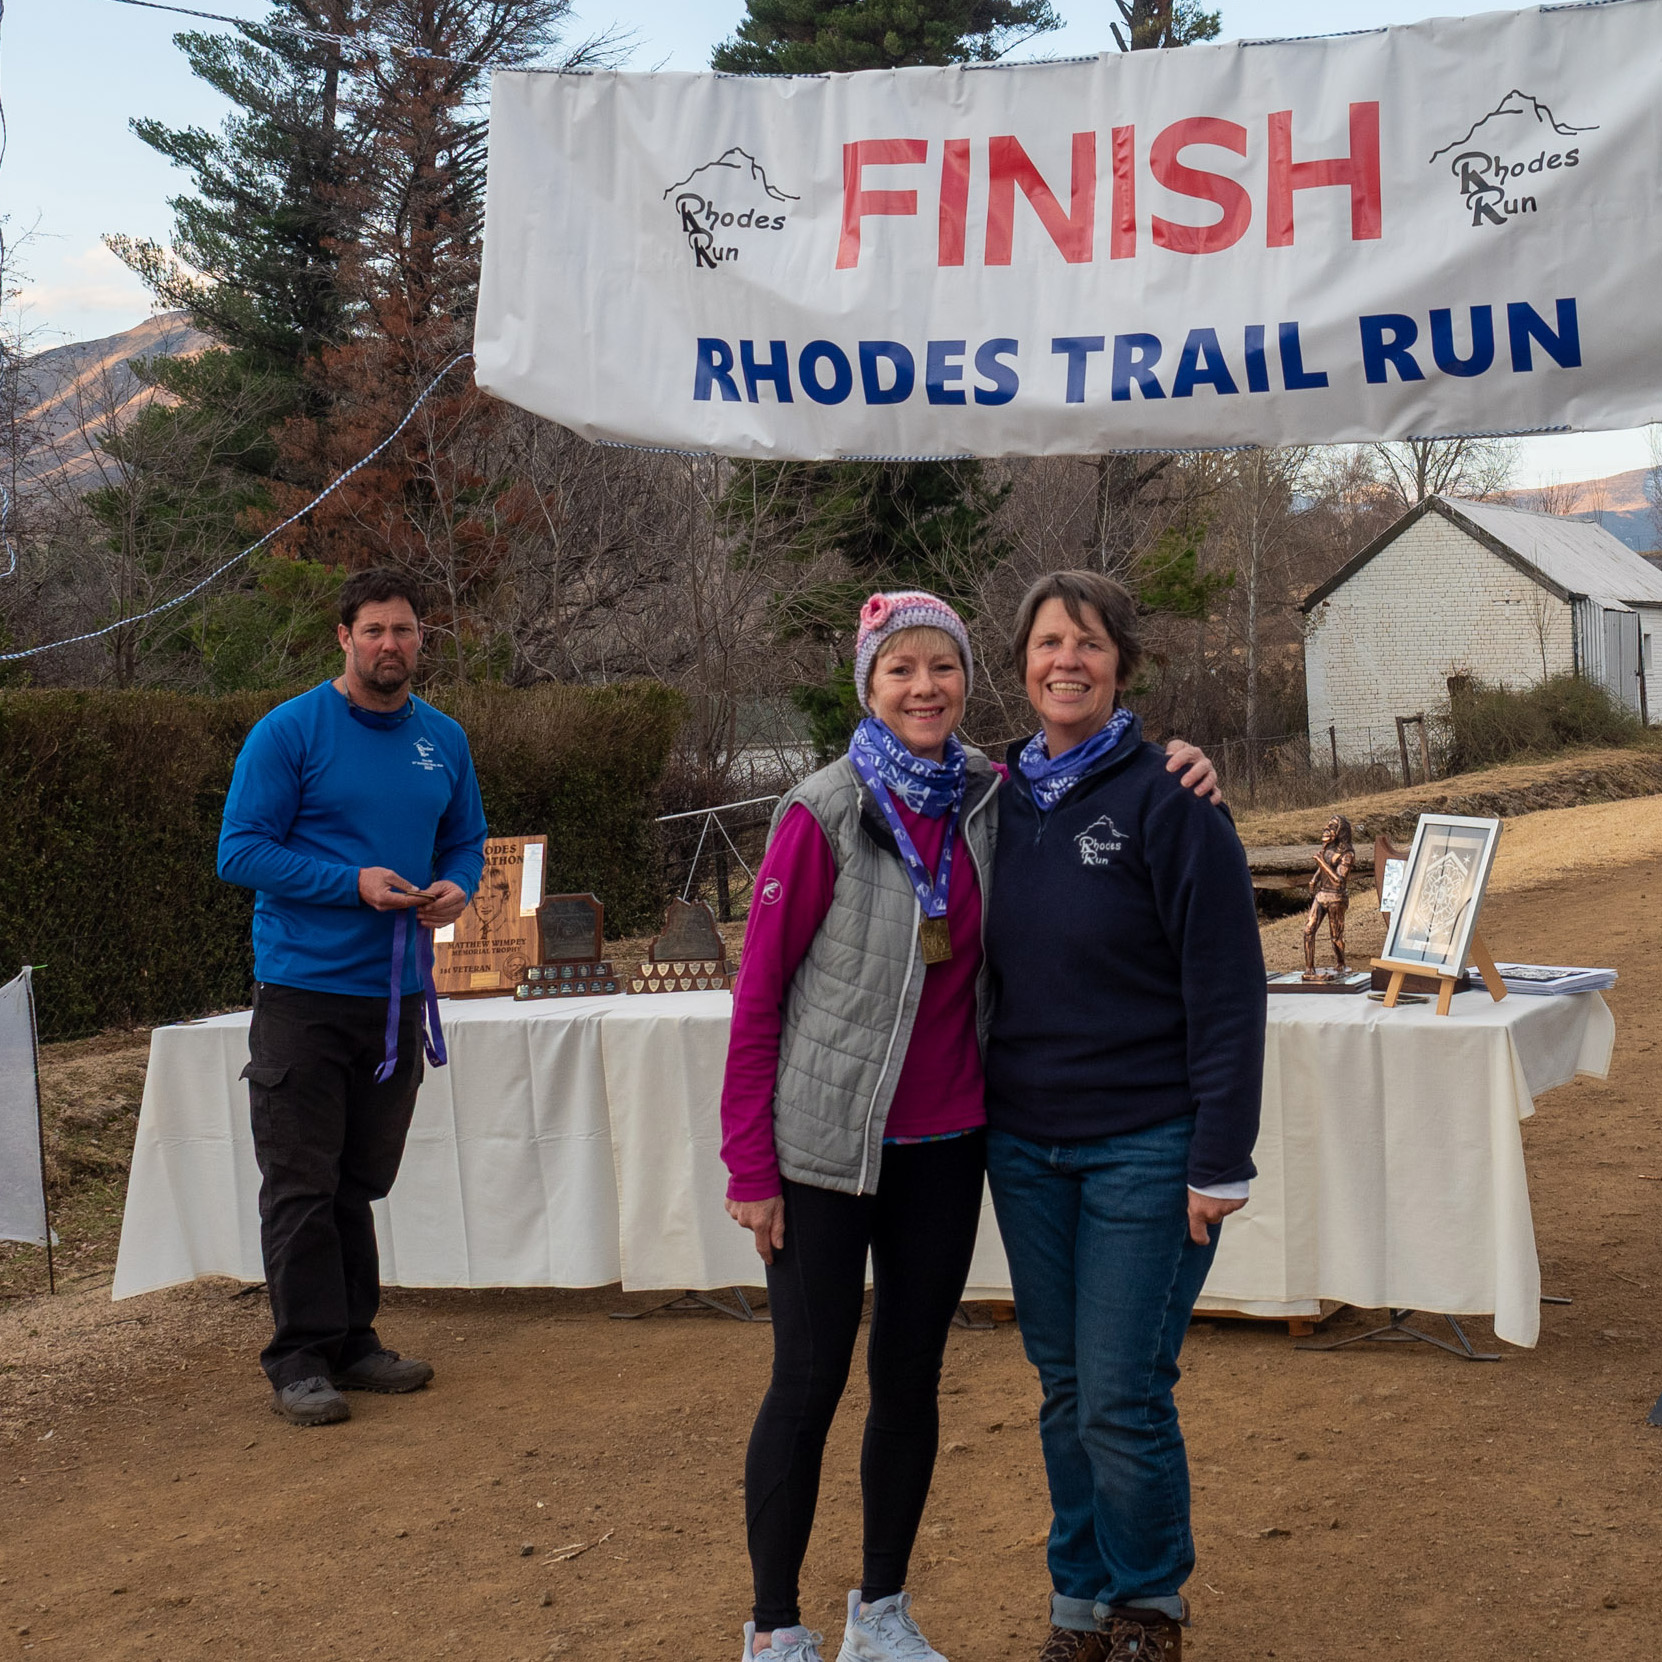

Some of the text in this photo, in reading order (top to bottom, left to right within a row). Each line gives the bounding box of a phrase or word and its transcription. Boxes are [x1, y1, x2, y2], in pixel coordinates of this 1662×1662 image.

[1452, 148, 1579, 194] Rhodes
[835, 101, 1382, 269] FINISH
[676, 193, 786, 232] Rhodes
[1467, 186, 1537, 226] Run
[689, 228, 739, 269] Run
[693, 297, 1582, 406] RHODES TRAIL RUN
[484, 845, 517, 855] ODES
[1079, 836, 1121, 853] Rhodes
[484, 855, 524, 866] ATHON
[1081, 850, 1109, 865] Run
[447, 941, 490, 949] MATTHEW
[451, 946, 522, 956] MEMORIAL TROPHY
[453, 965, 491, 973] VETERAN
